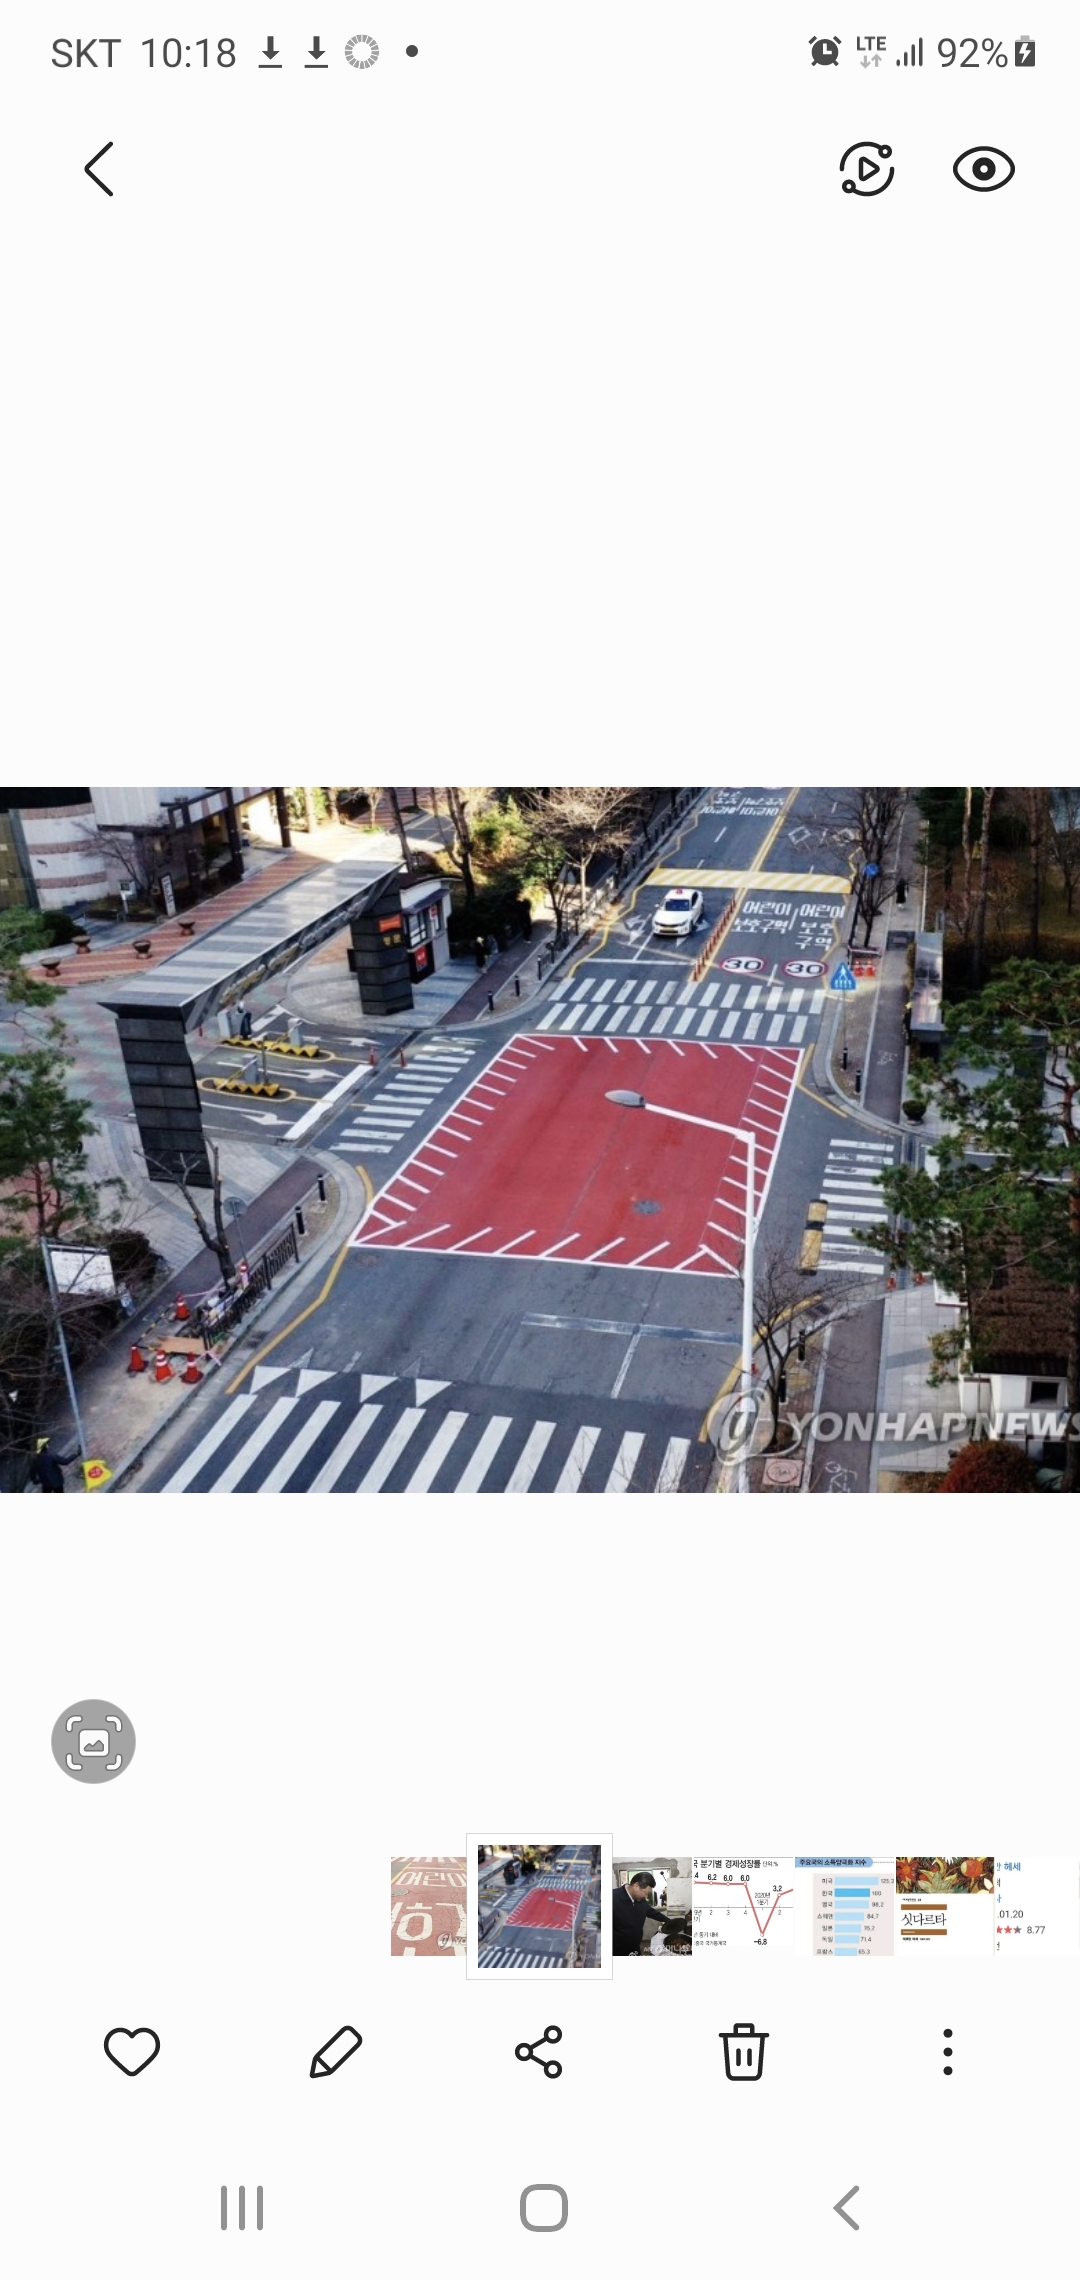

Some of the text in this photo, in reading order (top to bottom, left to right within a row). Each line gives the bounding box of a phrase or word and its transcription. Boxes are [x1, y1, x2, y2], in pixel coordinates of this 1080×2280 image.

[856, 36, 887, 51] LTE
[51, 38, 237, 68] SKT 10:18
[937, 37, 1008, 68] 92%
[742, 901, 792, 916] 어린이
[799, 903, 846, 919] 어린이
[731, 918, 789, 934] 보호구역
[723, 960, 762, 974] 30
[786, 964, 823, 977] 30
[700, 1859, 722, 1869] 분기별
[725, 1859, 761, 1869] 경제성장률
[1003, 1861, 1021, 1872] 헤세
[707, 1873, 717, 1881] 6.2
[723, 1874, 733, 1882] 6.0
[740, 1874, 750, 1882] 6.0
[901, 1912, 947, 1926] 싯다르타
[1026, 1925, 1046, 1935] 8.77
